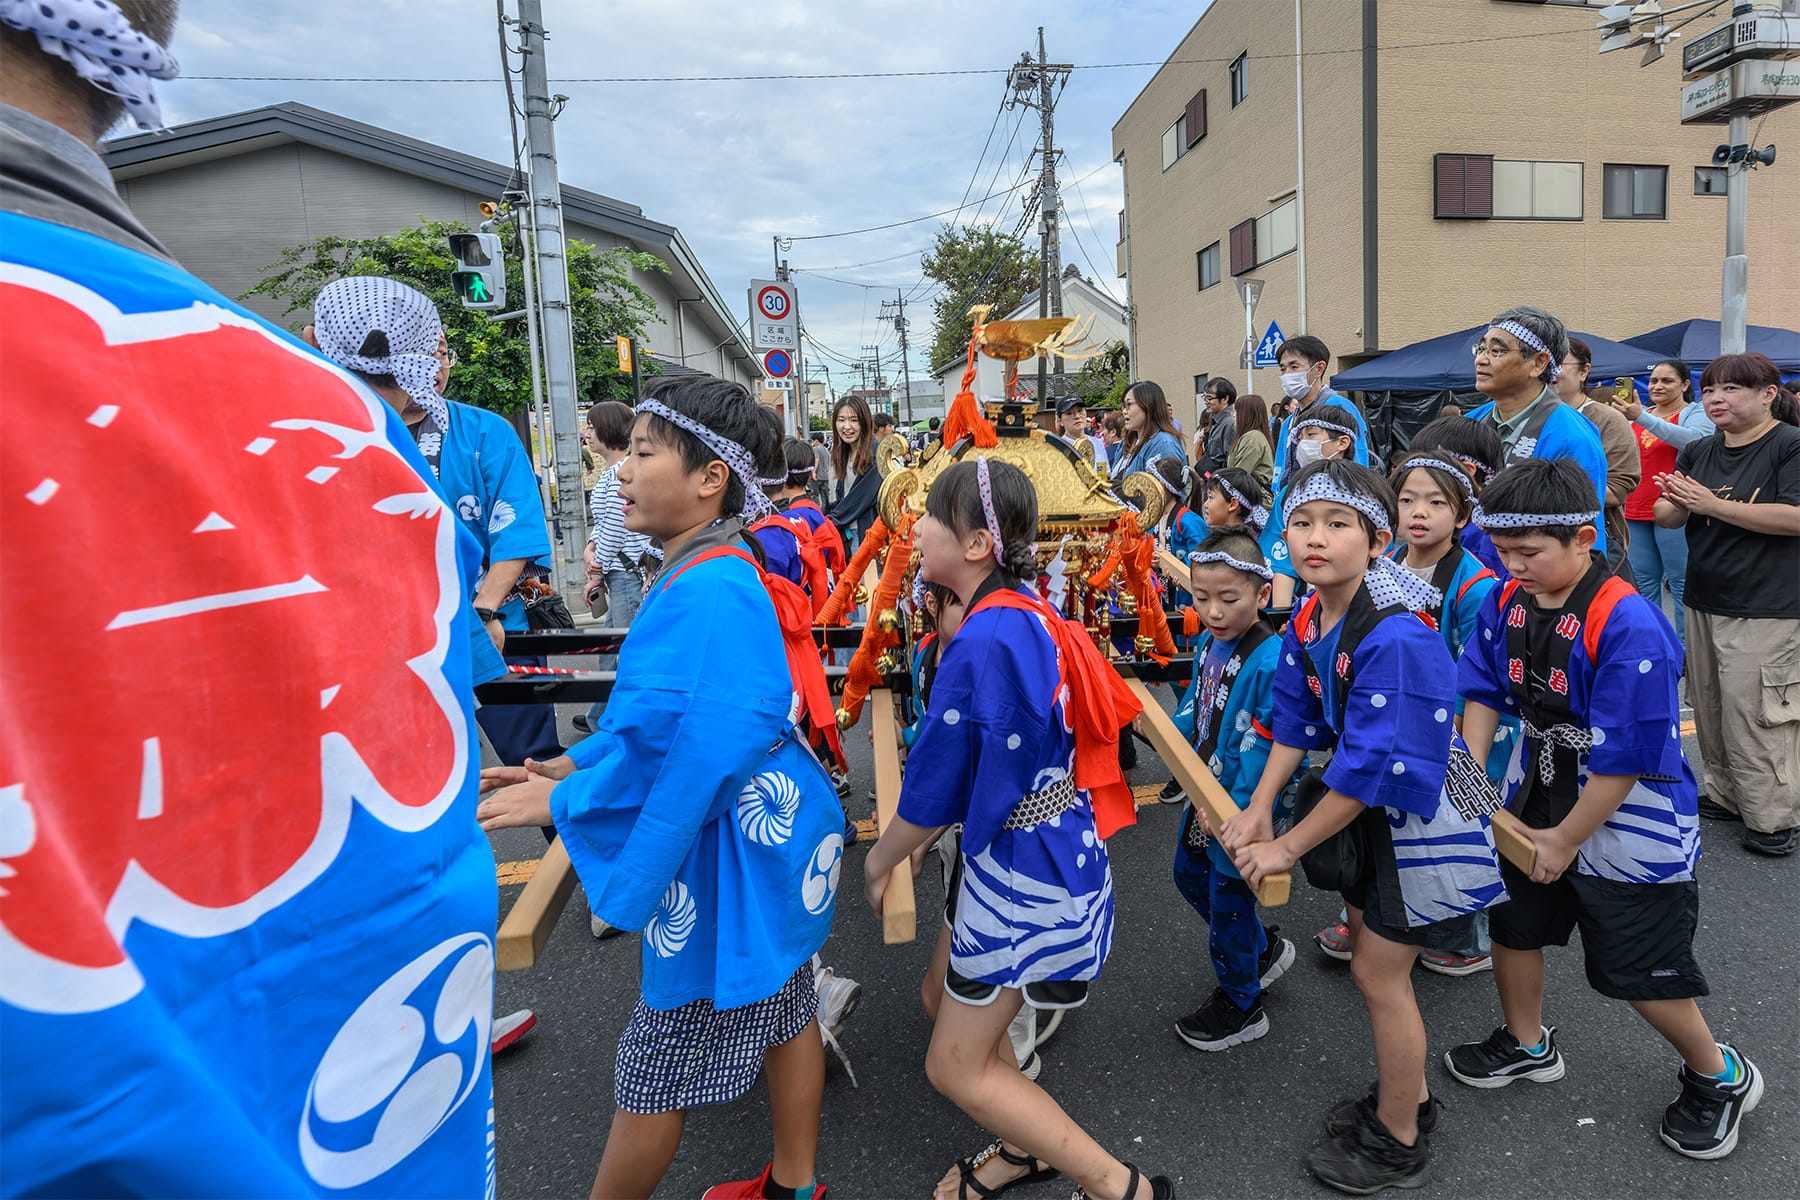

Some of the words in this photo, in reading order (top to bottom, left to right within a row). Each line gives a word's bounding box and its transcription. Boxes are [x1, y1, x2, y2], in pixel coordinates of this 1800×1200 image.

[765, 295, 784, 311] 30
[761, 334, 792, 344] ここから
